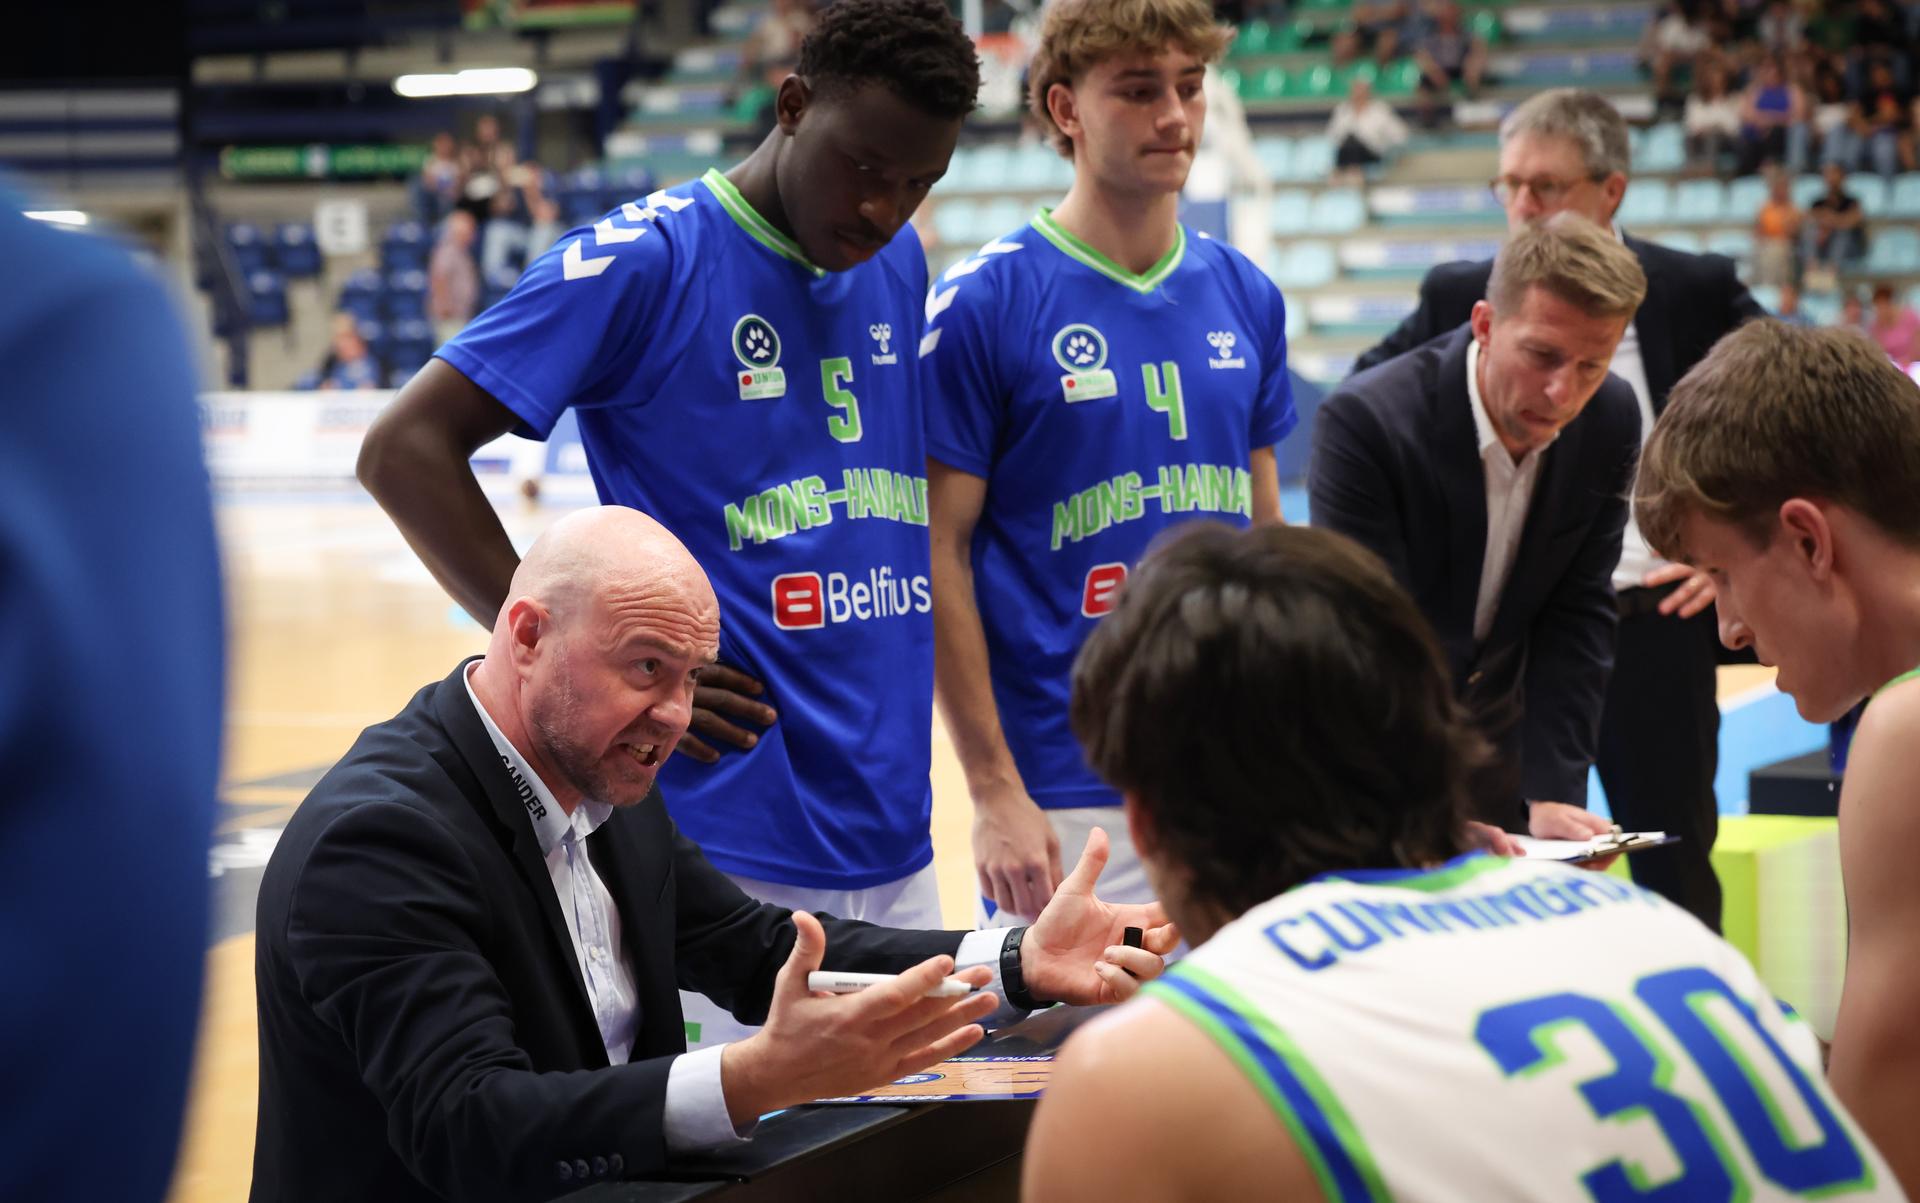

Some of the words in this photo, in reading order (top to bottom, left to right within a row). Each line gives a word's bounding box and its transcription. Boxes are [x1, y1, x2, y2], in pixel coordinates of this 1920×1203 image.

[820, 356, 863, 443] 5
[1141, 361, 1188, 440] 4
[828, 566, 932, 623] Belfius
[1472, 965, 1877, 1203] 30
